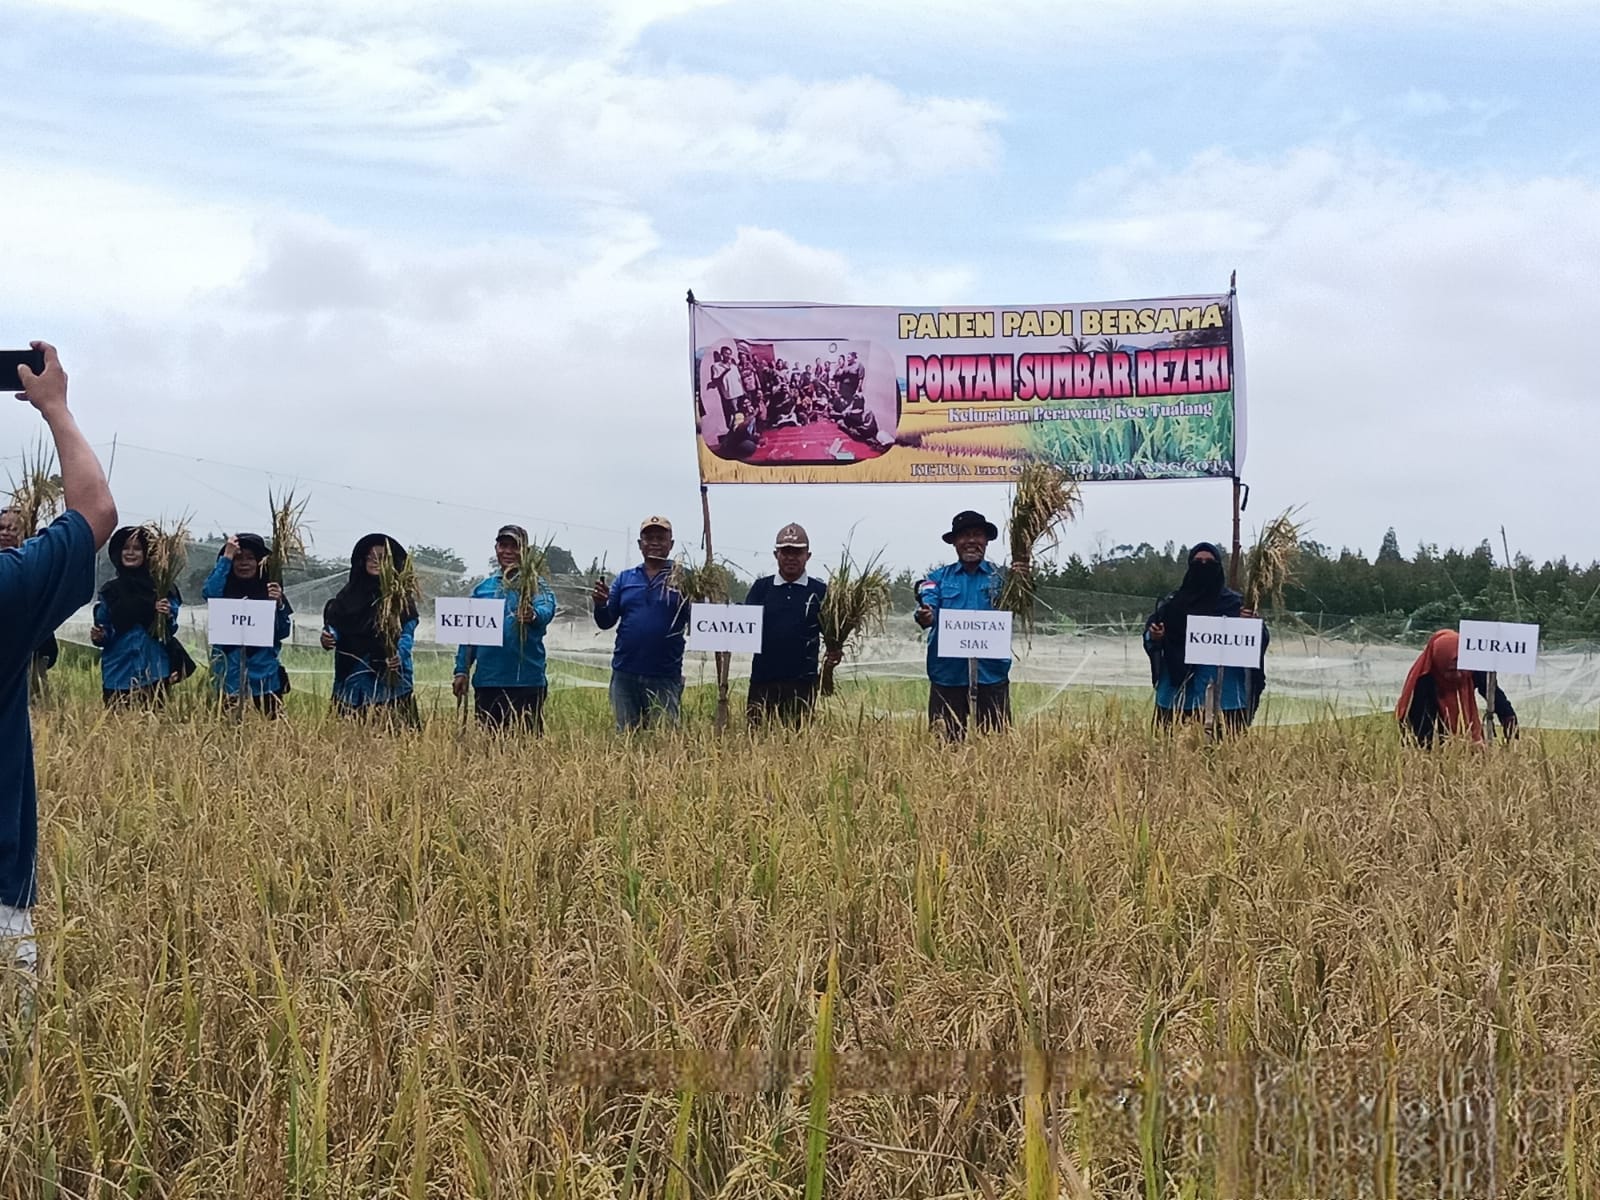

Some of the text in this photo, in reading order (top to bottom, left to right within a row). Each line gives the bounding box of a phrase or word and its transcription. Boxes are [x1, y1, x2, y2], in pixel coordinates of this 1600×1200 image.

[898, 303, 1223, 339] PANEN PADI BERSAMA
[905, 345, 1231, 402] POKTAN SUMBAR REZEKI
[948, 406, 1029, 422] Kelurahan
[1033, 405, 1111, 424] Perawang
[910, 463, 970, 477] KETUA
[231, 614, 256, 627] PPL
[440, 613, 498, 629] KETUA
[696, 620, 757, 635] CAMAT
[945, 619, 1006, 631] KADISTAN
[959, 639, 989, 650] SIAK
[1189, 631, 1256, 647] KORLUH
[1465, 637, 1527, 654] LURAH
